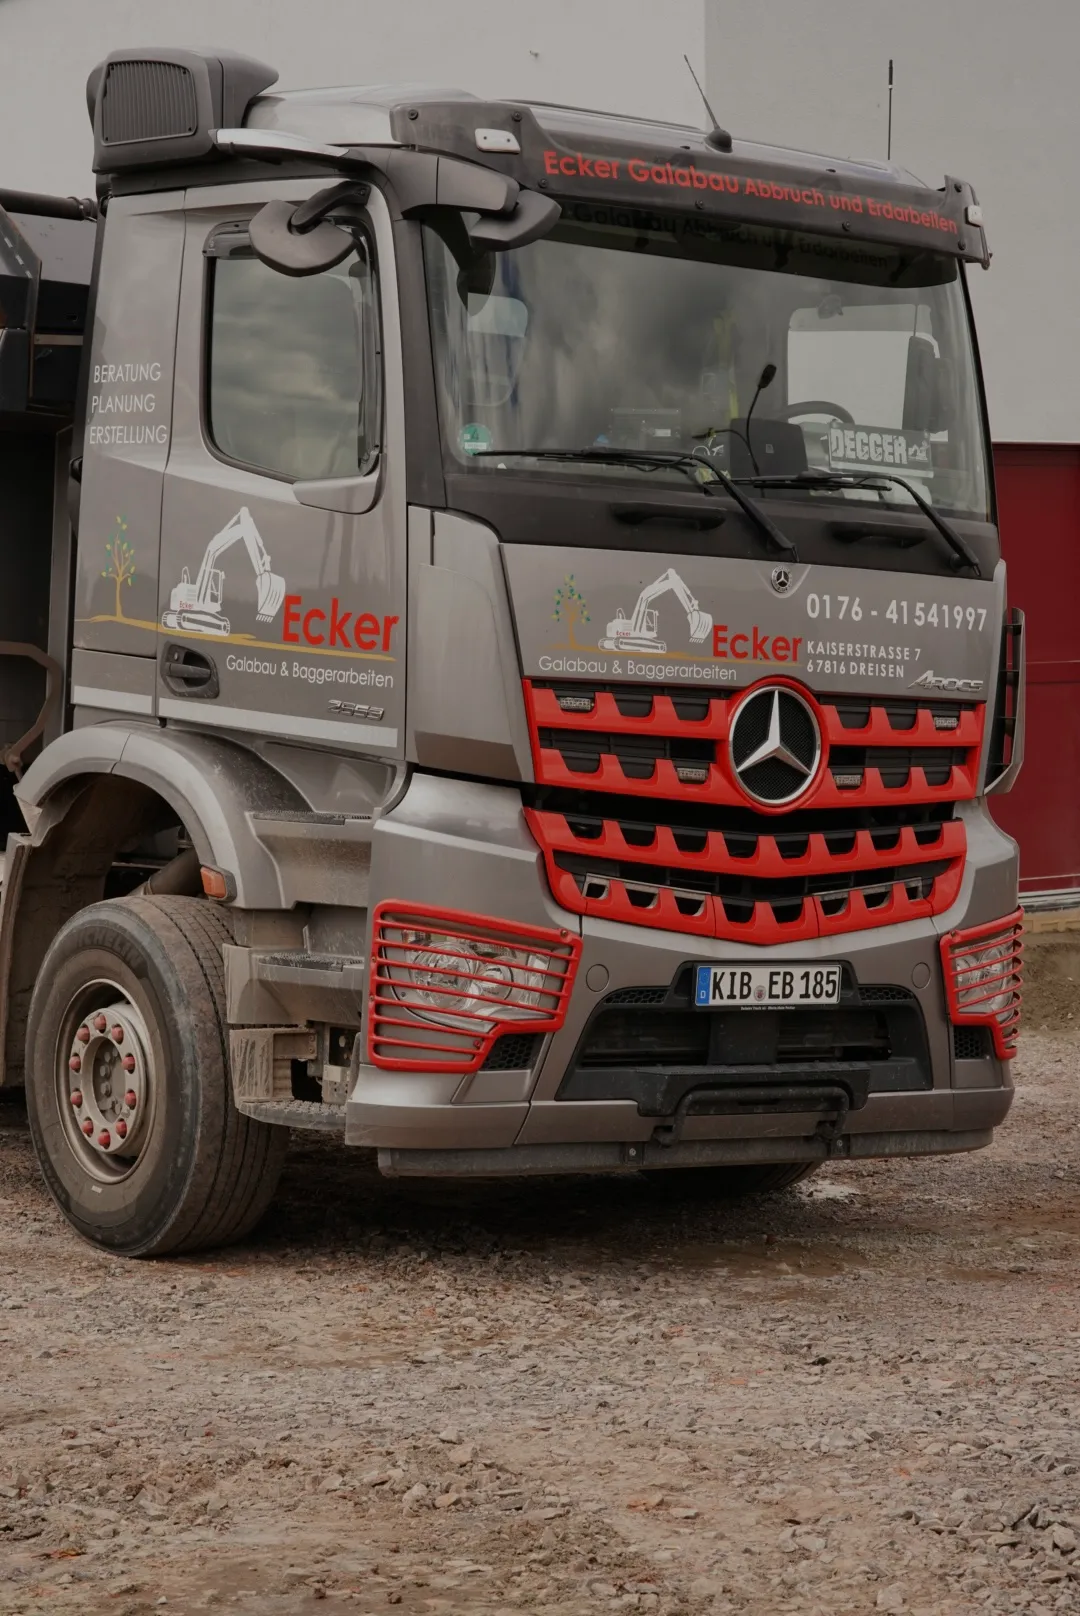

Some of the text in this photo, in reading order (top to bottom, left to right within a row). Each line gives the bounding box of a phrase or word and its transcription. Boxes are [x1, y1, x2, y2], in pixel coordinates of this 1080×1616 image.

[543, 151, 958, 235] Ecker Galabau Abbruch und Erdarbeiten
[93, 362, 161, 383] BERATUNG
[91, 394, 156, 413] PLANUNG
[89, 424, 168, 445] ERSTELLUNG
[282, 594, 401, 652] Ecker
[806, 592, 863, 622] 0176
[885, 598, 988, 632] 41541997
[712, 624, 802, 663] Ecker
[807, 640, 922, 661] KAISERSTRASSE 7
[226, 654, 394, 688] Galabau & Baggerarbeiten
[538, 655, 738, 681] Galabau & Baggerarbeiten
[806, 658, 906, 679] 67816 DREISEN
[75, 926, 144, 968] ICHELIN
[712, 970, 837, 1000] KIB EB 185
